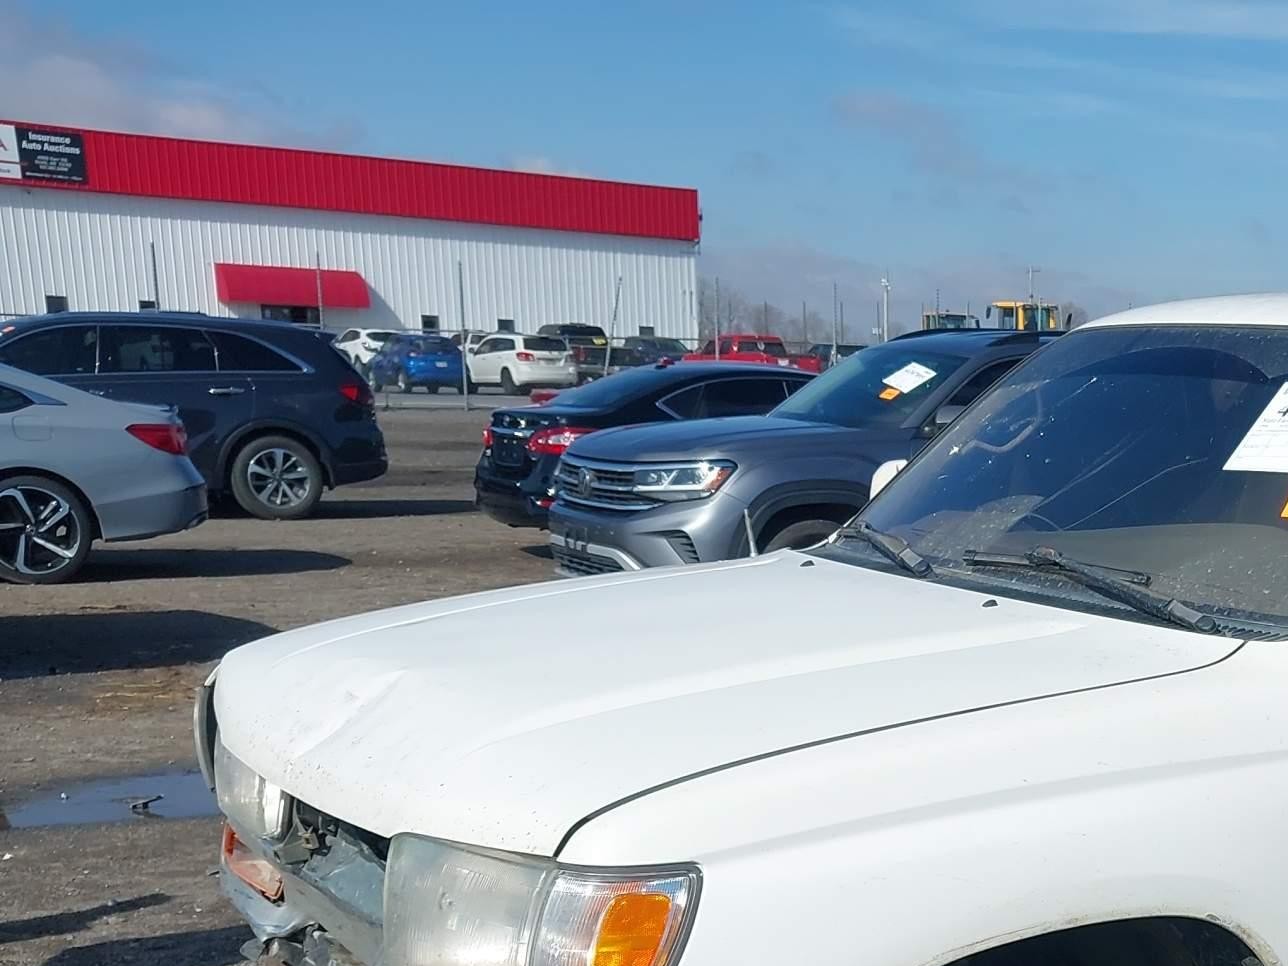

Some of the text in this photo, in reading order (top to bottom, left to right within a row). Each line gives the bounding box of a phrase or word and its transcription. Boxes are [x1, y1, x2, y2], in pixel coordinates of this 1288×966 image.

[28, 131, 71, 144] Insurance
[22, 140, 80, 155] Auto Auctions
